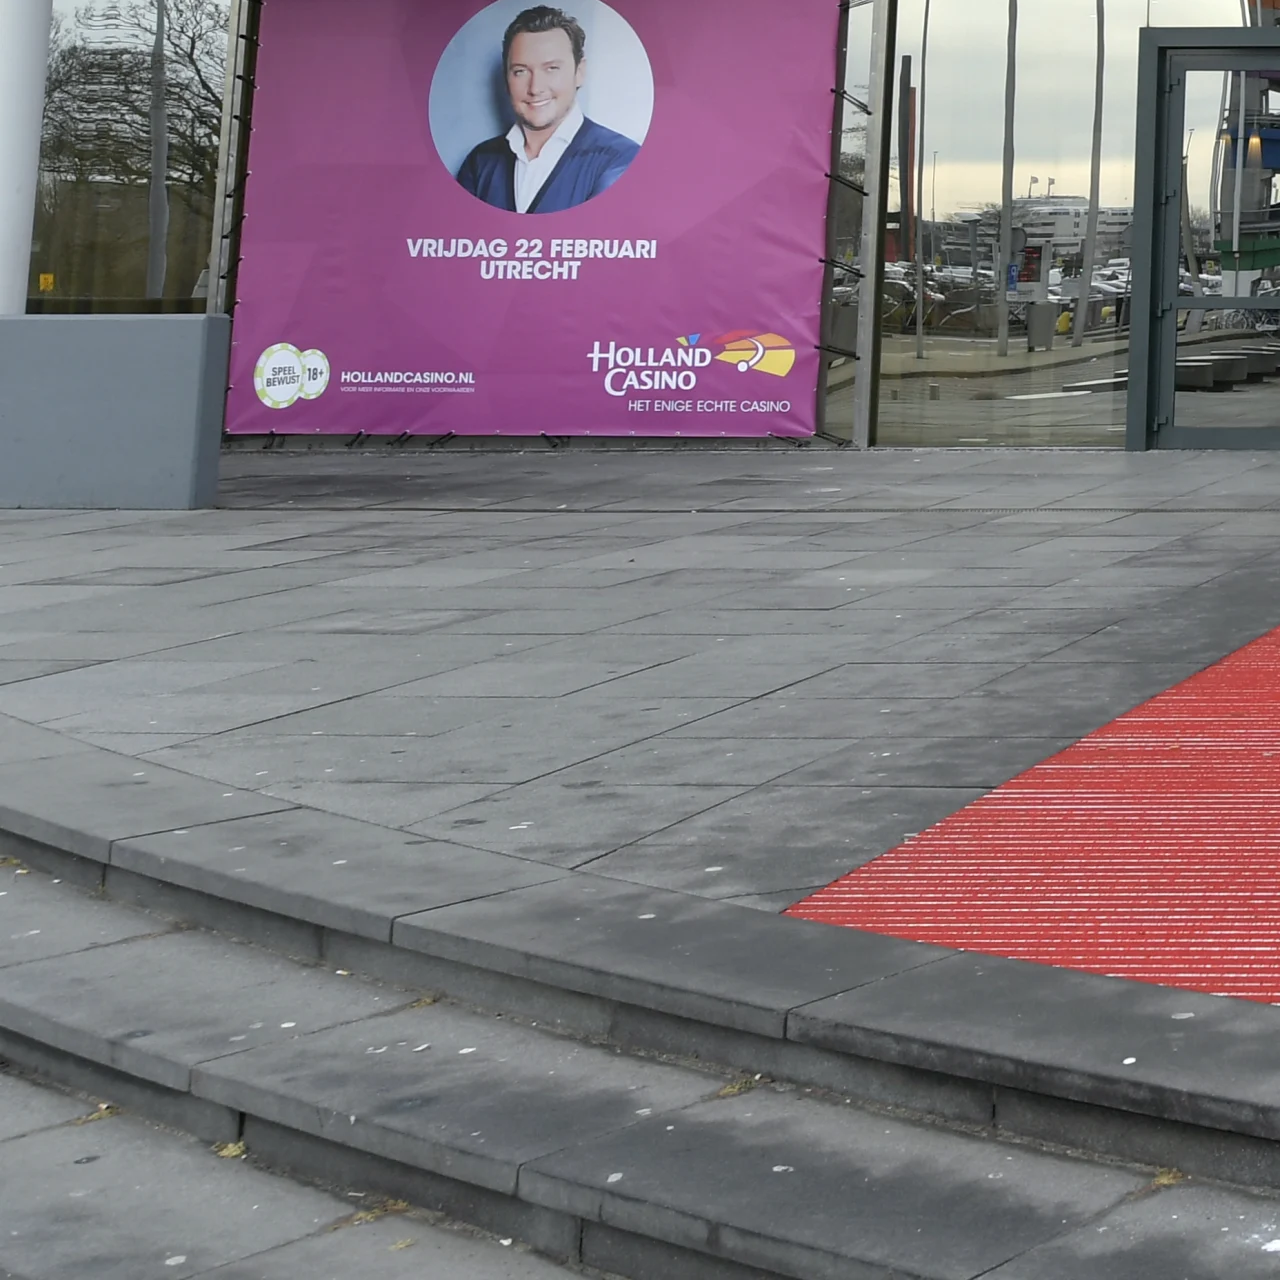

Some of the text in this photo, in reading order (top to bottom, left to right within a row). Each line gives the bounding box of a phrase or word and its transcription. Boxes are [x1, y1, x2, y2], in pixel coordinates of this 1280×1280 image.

[406, 239, 657, 259] VRIJDAG 22 FEBRUARI
[480, 261, 581, 280] UTRECHT
[587, 341, 711, 371] HOLLAND
[271, 366, 296, 377] SPEEL
[307, 368, 324, 381] 18+
[341, 372, 475, 384] HOLLANDCASINO.NL
[266, 375, 300, 387] BEWUST
[604, 368, 696, 396] CASINO
[628, 400, 790, 412] HET ENIGE ECHTE CASINO
